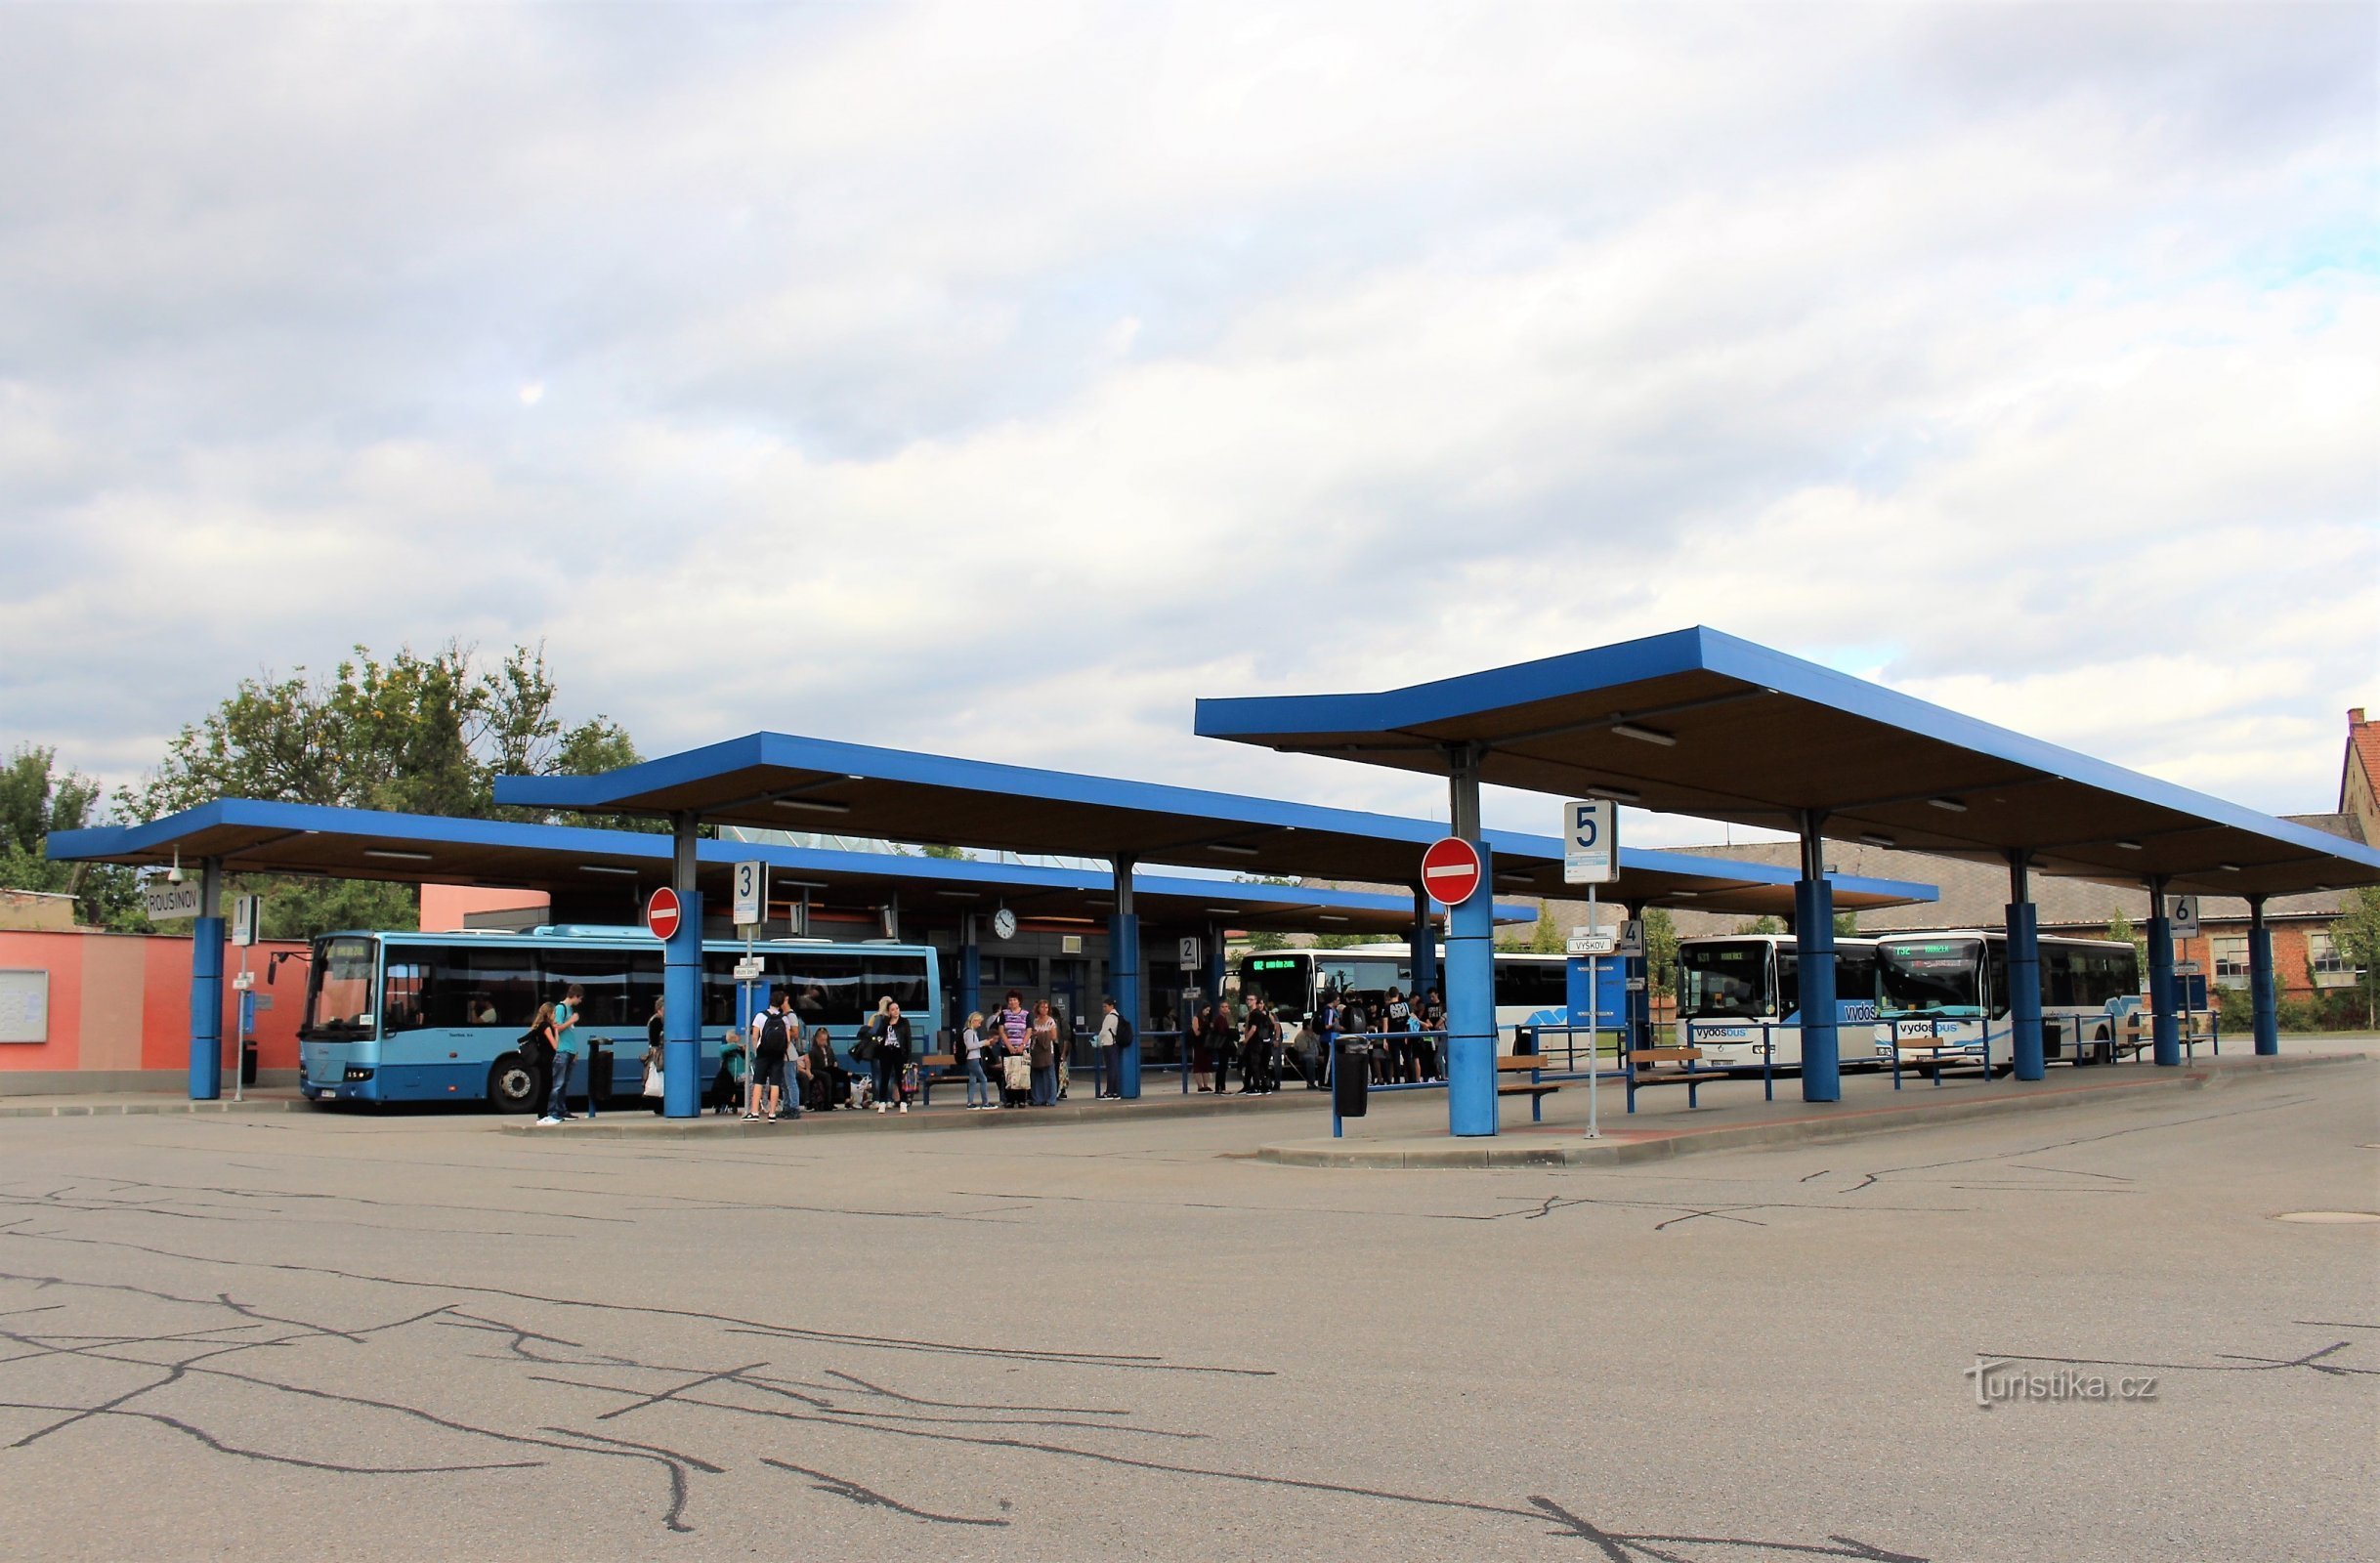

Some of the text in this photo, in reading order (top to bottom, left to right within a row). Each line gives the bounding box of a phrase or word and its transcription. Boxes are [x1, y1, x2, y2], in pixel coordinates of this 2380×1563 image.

[1576, 806, 1597, 848] 5
[740, 865, 751, 897] 3
[238, 899, 243, 924] 1
[2176, 899, 2189, 920] 6
[1625, 922, 1636, 942] 4
[1183, 939, 1192, 957] 2
[1575, 939, 1605, 950] VYŠKOV
